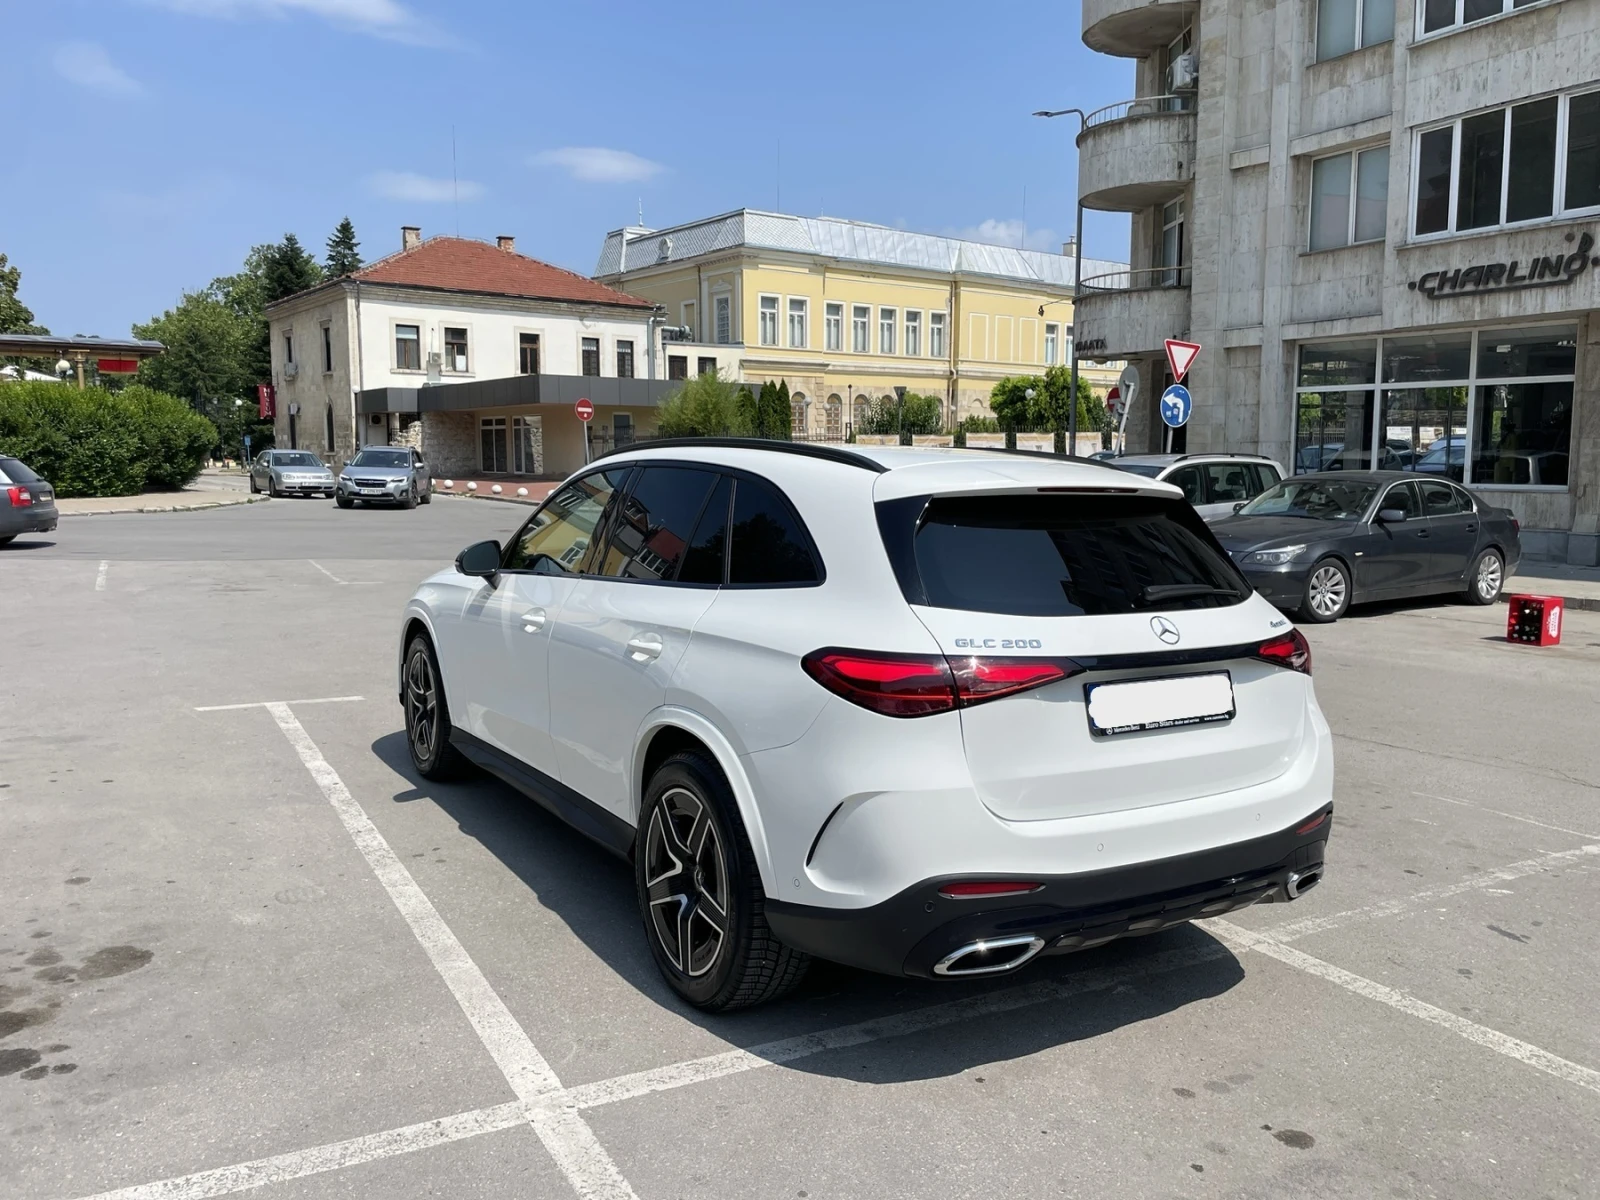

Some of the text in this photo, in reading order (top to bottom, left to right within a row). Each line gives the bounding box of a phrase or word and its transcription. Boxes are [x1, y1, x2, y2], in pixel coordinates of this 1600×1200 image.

[1418, 234, 1593, 300] CHARLINO
[955, 638, 1042, 649] GLC 200
